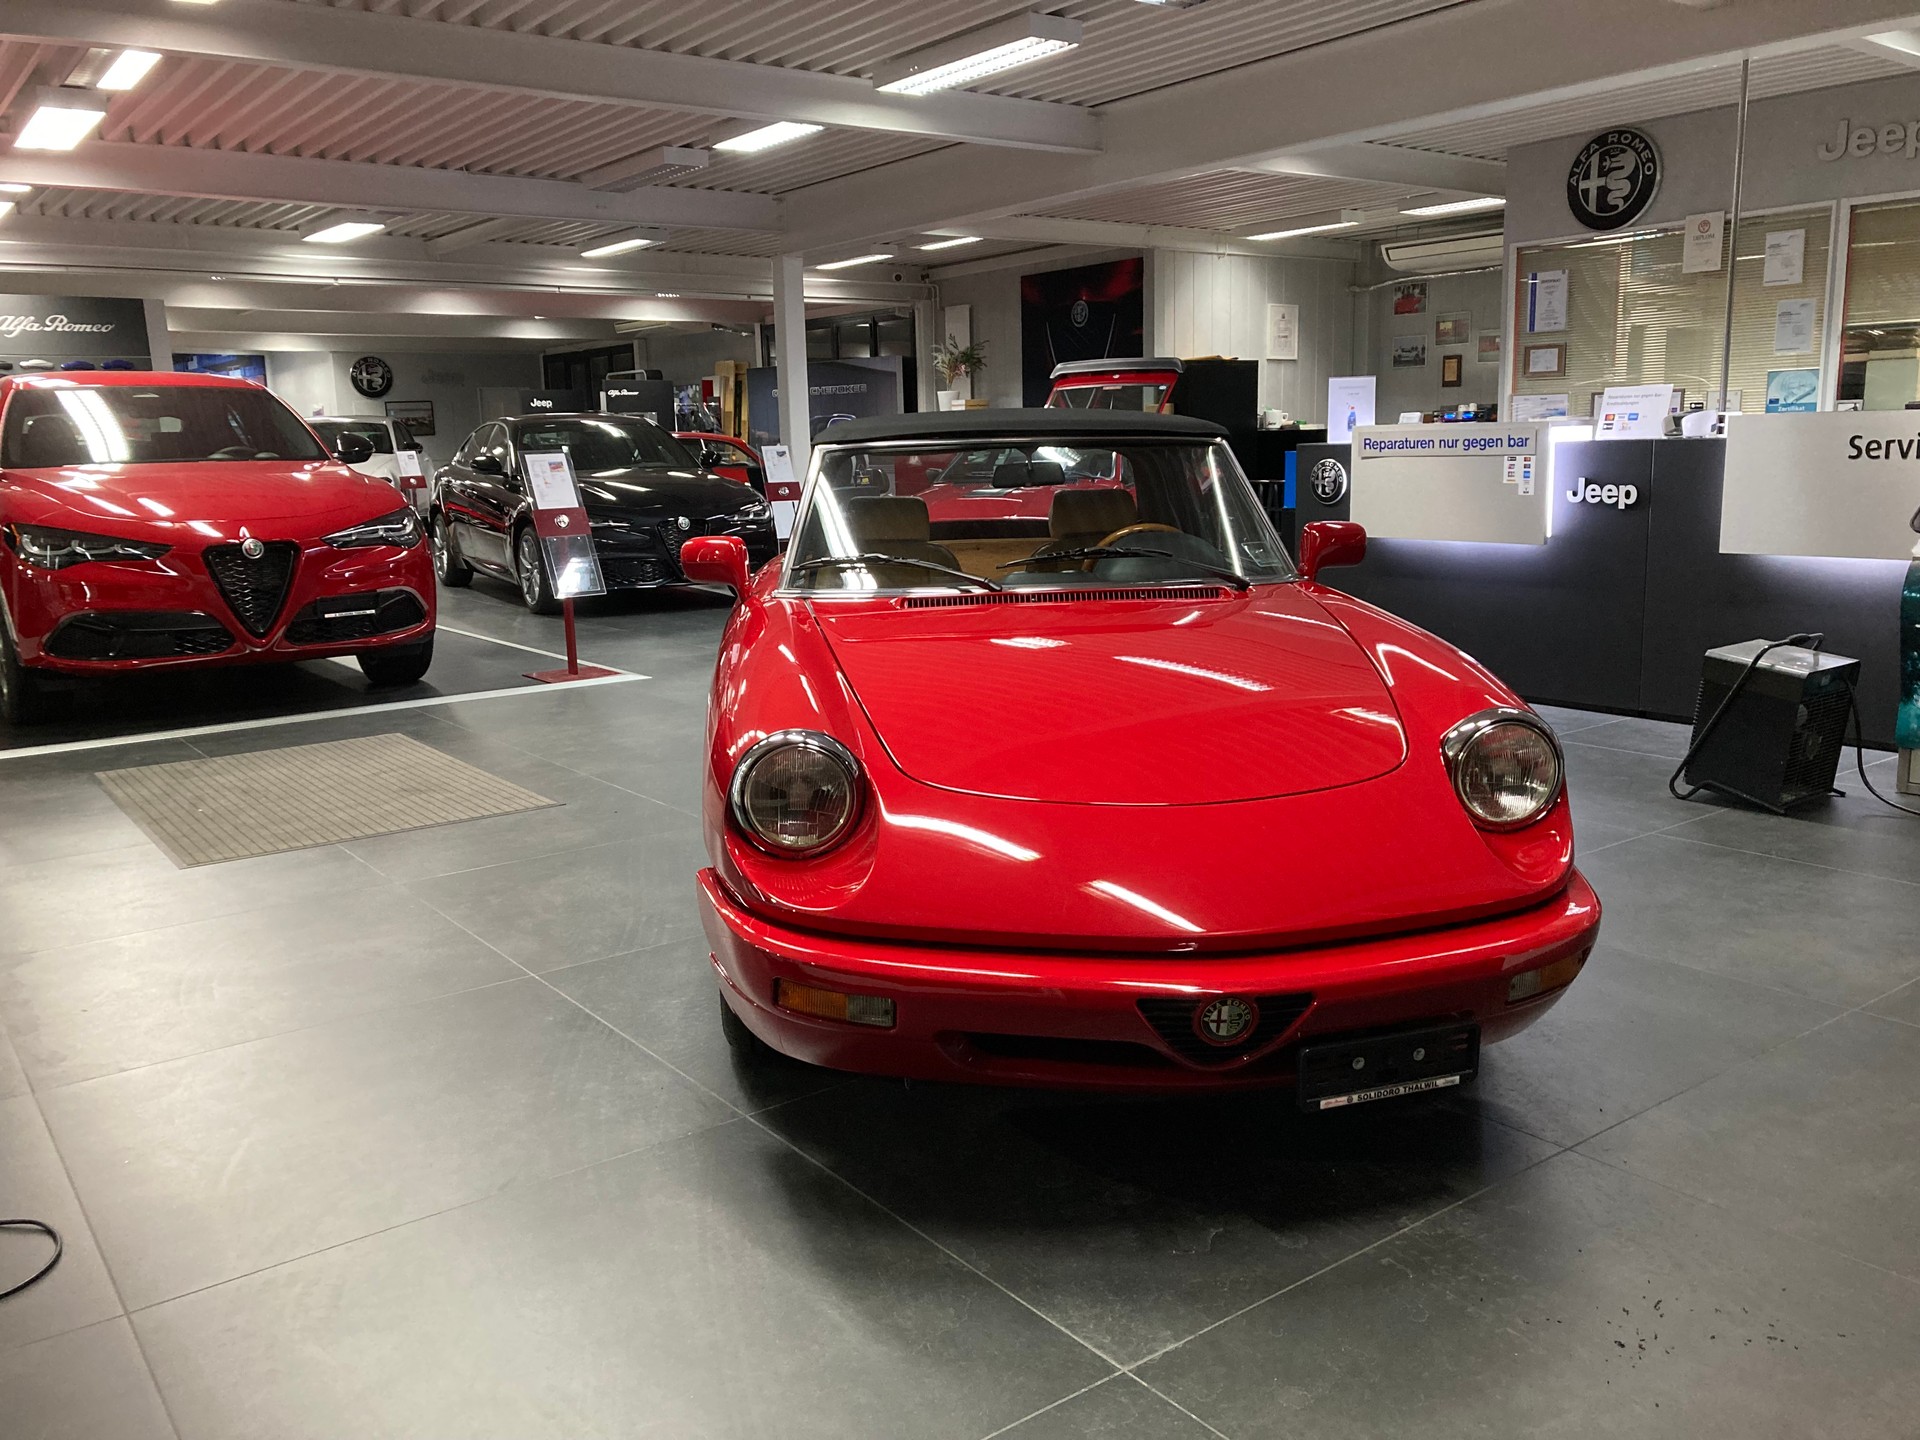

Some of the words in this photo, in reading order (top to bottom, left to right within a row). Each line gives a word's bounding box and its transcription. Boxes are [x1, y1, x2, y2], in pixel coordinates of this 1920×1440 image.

[1569, 143, 1599, 187] ALFA
[1607, 133, 1654, 175] ROMEO
[0, 315, 43, 338] Alfa
[44, 314, 115, 333] Romeo
[809, 383, 868, 396] CHEROKEE
[530, 398, 553, 409] Jeep
[1777, 405, 1805, 413] Zertifikat
[1363, 437, 1435, 452] Reparaturen
[1438, 437, 1459, 449] nur
[1462, 436, 1503, 451] gegen
[1507, 434, 1529, 448] bar
[1847, 431, 1920, 461] Servi
[1324, 461, 1343, 483] ROMEO
[1566, 477, 1638, 510] Jeep
[1203, 1002, 1222, 1022] ALFA
[1226, 999, 1251, 1021] ROMEO
[1357, 1087, 1401, 1102] SOLIDORO
[1403, 1081, 1440, 1093] THALWIL
